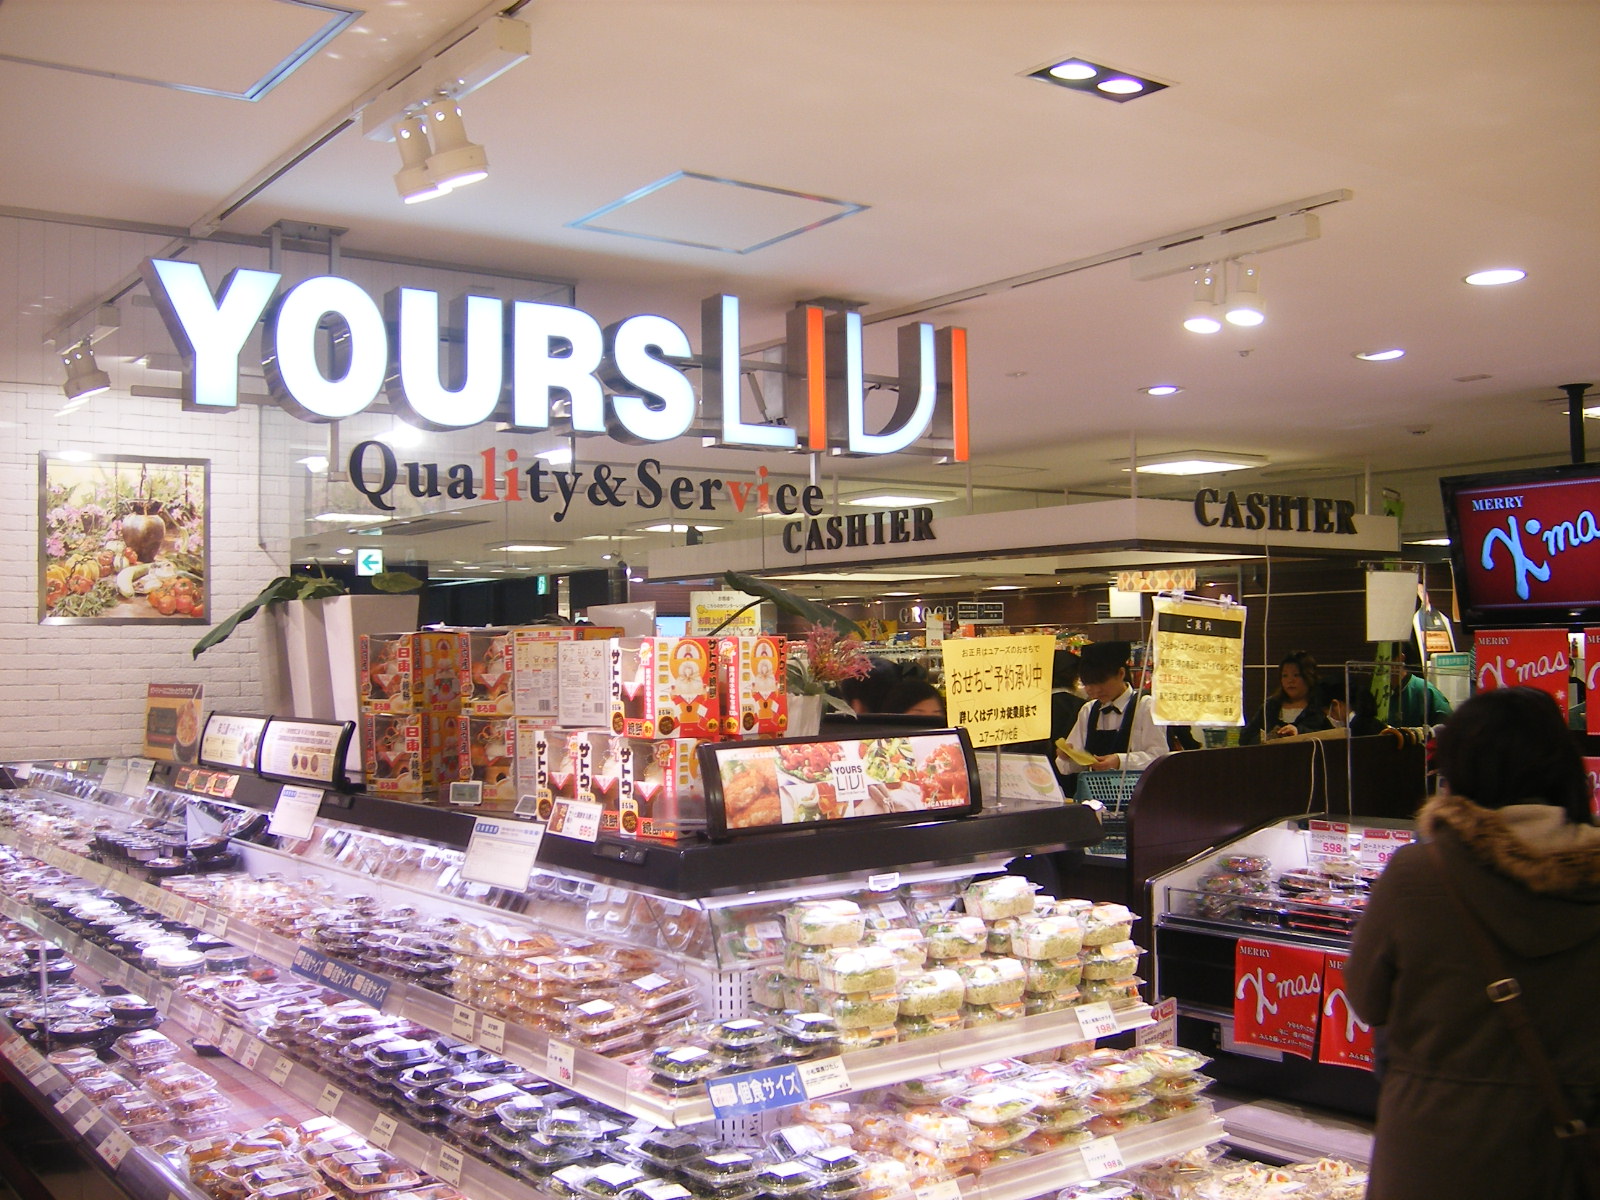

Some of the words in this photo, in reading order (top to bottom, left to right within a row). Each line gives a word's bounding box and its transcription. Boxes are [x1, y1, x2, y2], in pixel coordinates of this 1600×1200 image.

[150, 256, 696, 442] YOURS
[1194, 487, 1359, 535] CASHIER
[1472, 496, 1524, 512] MERRY
[782, 506, 937, 554] CASHIER
[1478, 636, 1510, 645] MERRY
[951, 662, 1042, 696] おせちご予約承り中
[834, 765, 863, 775] YOURS
[1240, 946, 1271, 958] MERRY
[737, 1071, 801, 1106] 個食サイズ
